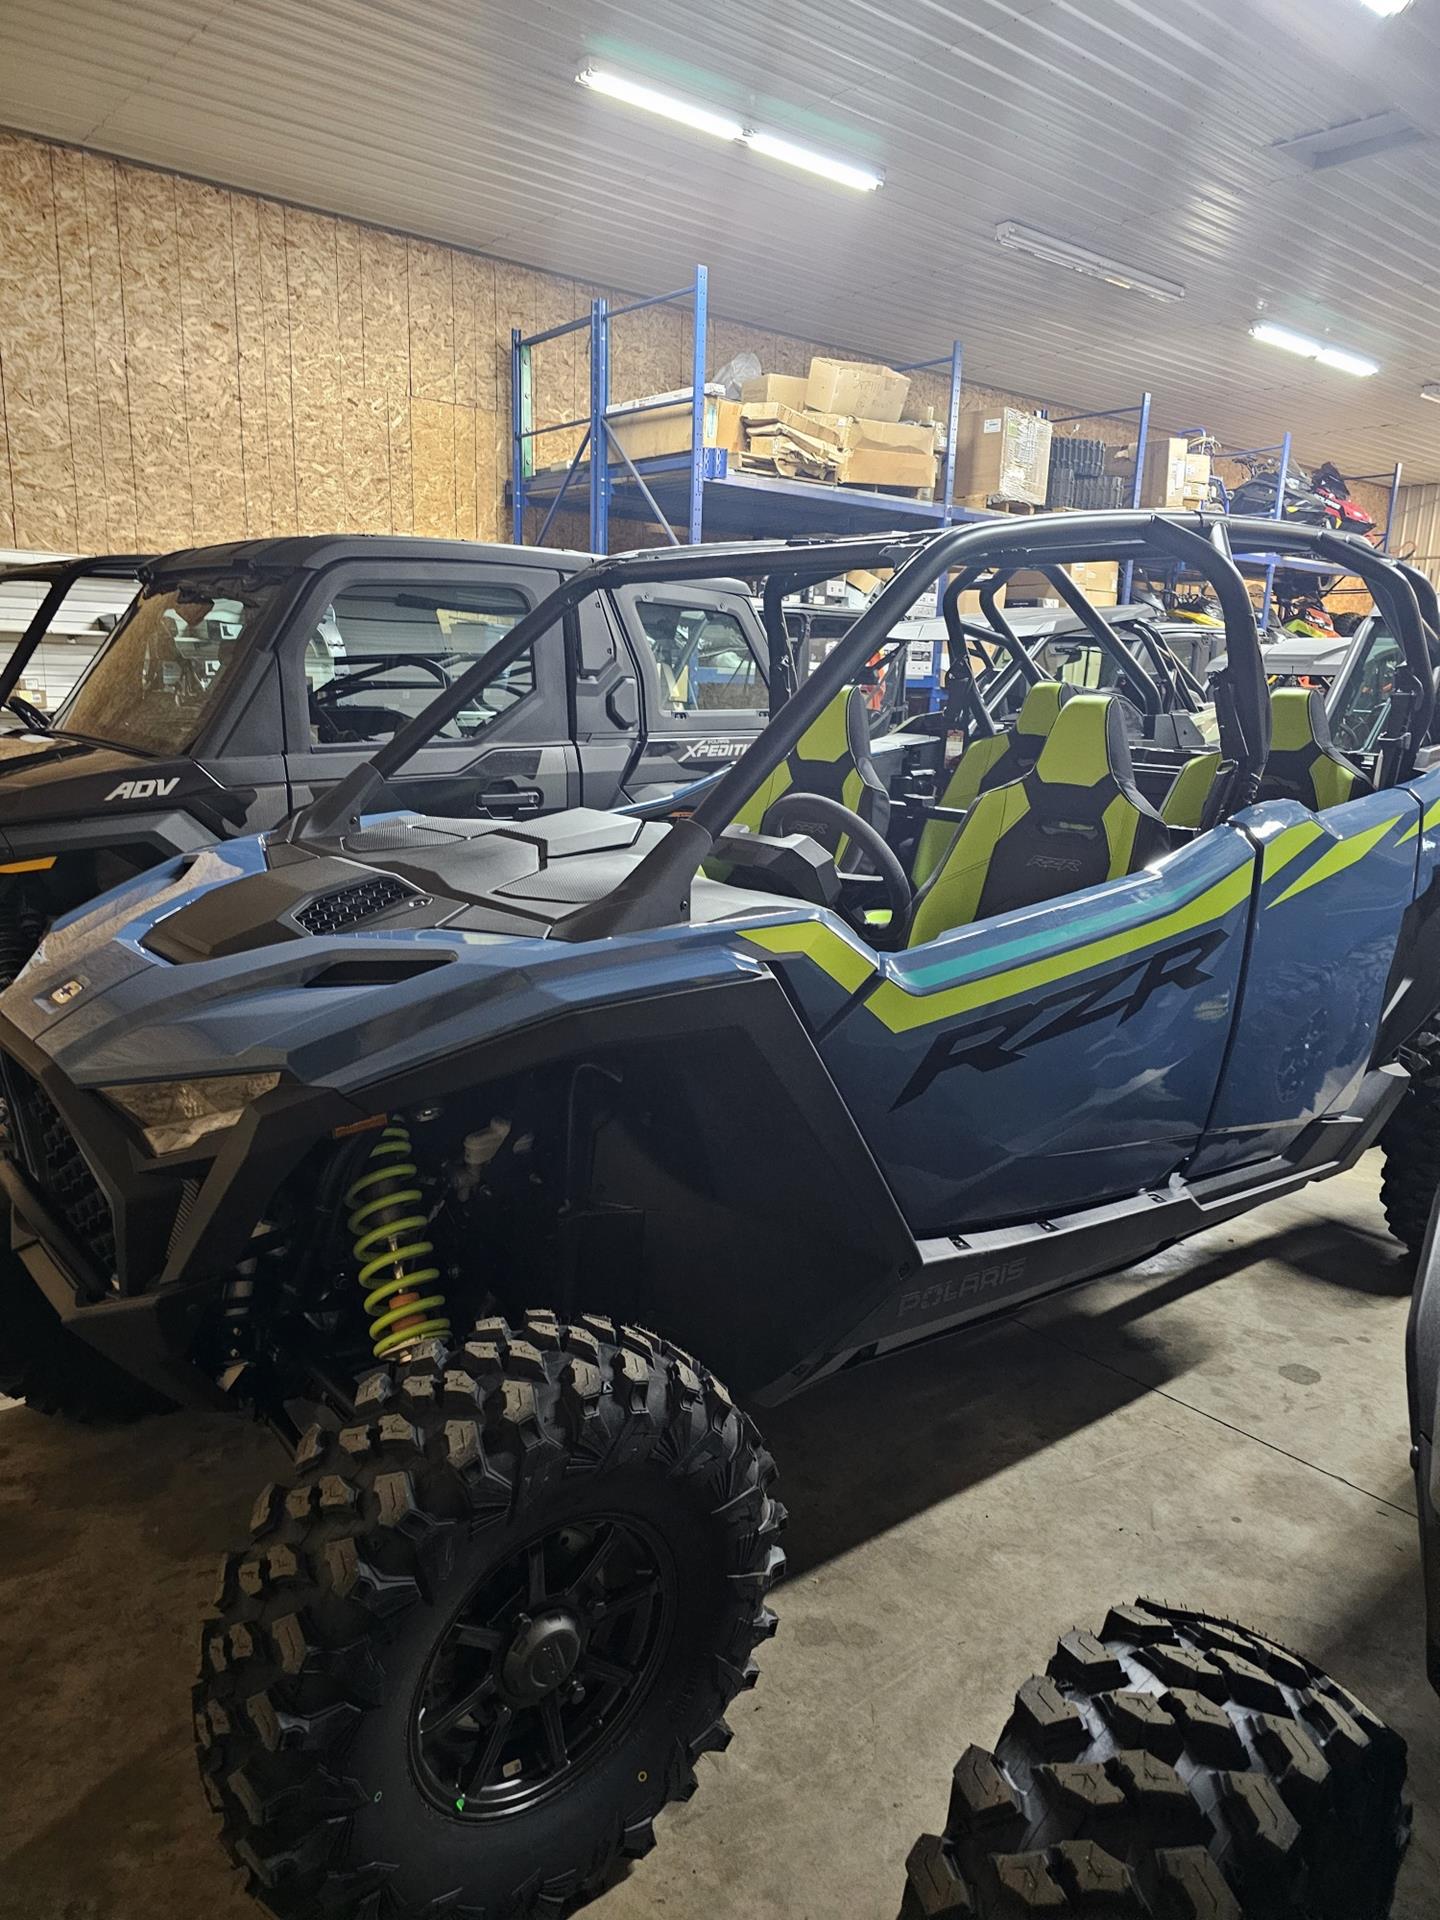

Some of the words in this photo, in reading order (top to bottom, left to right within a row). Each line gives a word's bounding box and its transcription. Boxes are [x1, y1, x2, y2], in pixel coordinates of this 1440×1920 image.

[678, 740, 751, 762] XPEDITI
[104, 777, 181, 801] ADV
[1026, 854, 1082, 872] RZR
[889, 928, 1230, 1112] RZR
[897, 1257, 1027, 1317] POLARIS
